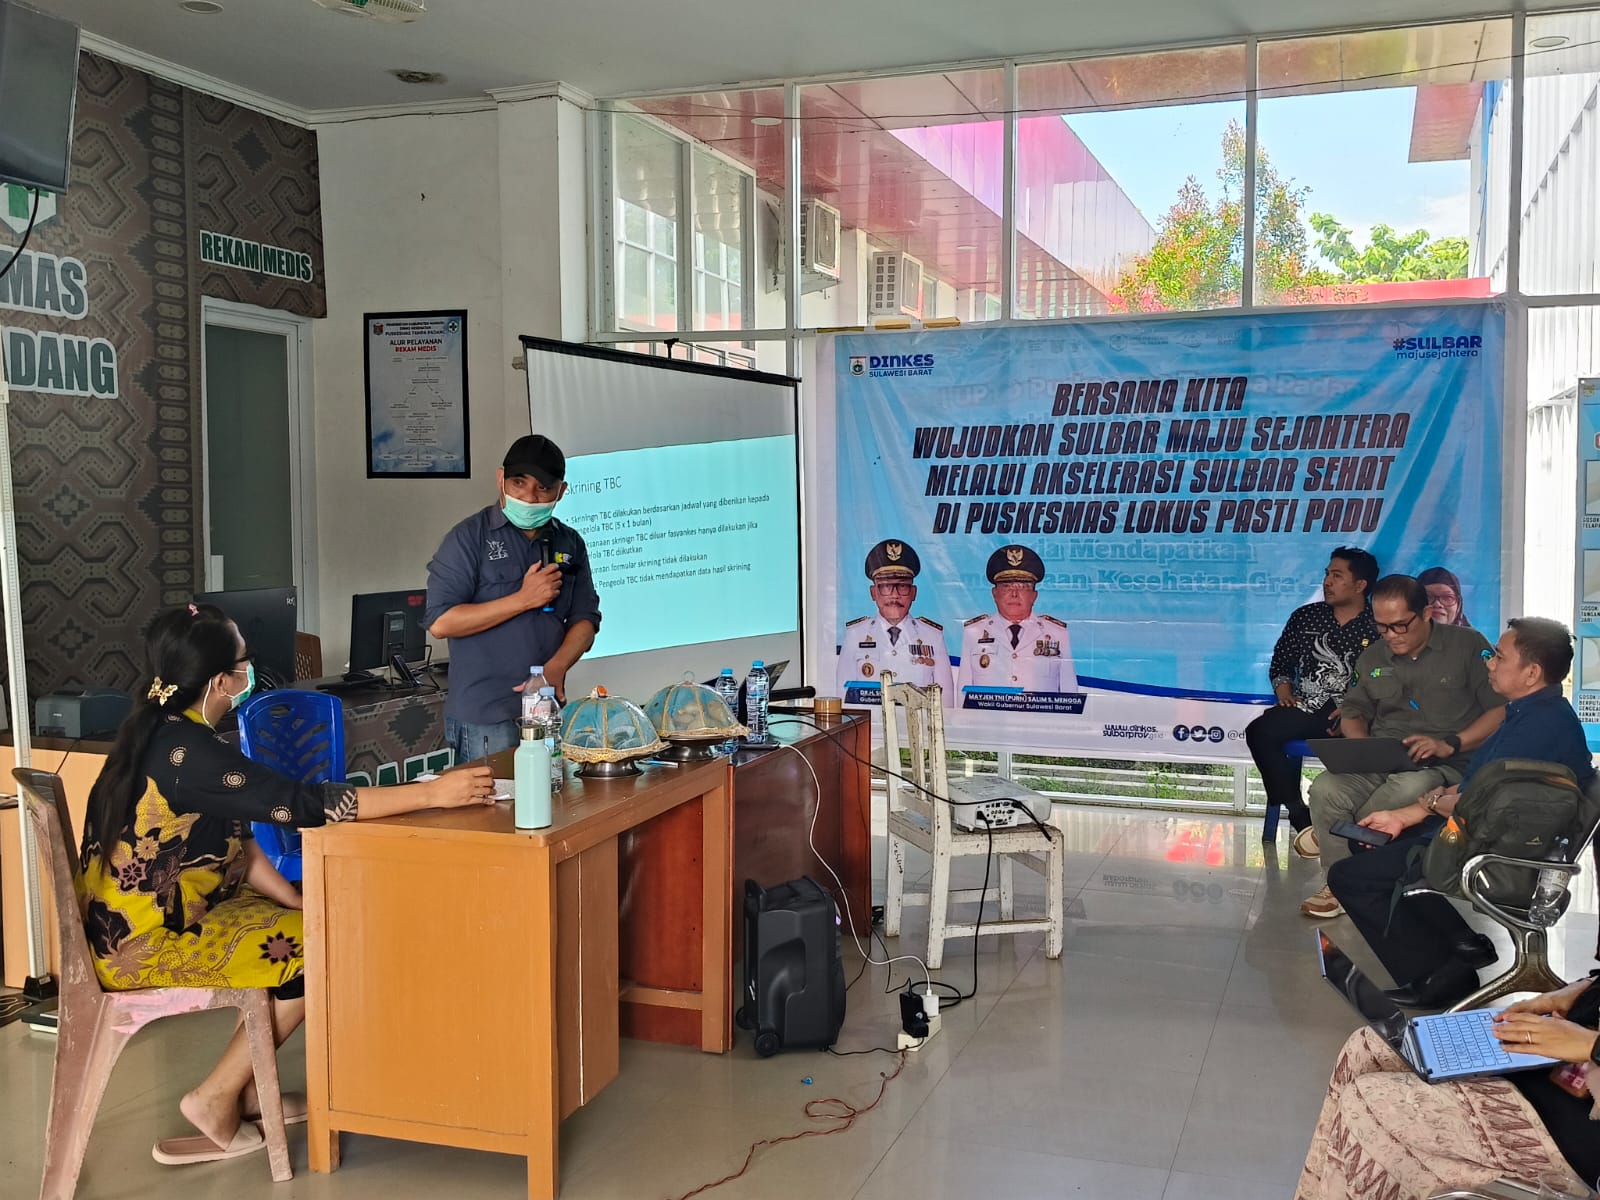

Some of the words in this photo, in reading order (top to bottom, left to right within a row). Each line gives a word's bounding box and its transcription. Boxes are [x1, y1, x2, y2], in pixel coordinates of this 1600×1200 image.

[200, 231, 260, 272] REKAM
[262, 245, 312, 282] MEDIS
[1393, 336, 1482, 351] #SULBAR
[2, 330, 116, 396] DANG
[1397, 349, 1478, 360] majusejahtera
[1052, 378, 1178, 416] BERSAMA
[1182, 376, 1247, 412] KITA
[912, 423, 1054, 459] WUJUDKAN
[1059, 420, 1160, 456] SULBAR
[1165, 418, 1246, 453] MAJU
[1250, 413, 1410, 451] SEJAHTERA
[604, 476, 622, 490] TBC
[925, 463, 1026, 497] MELALUI
[1030, 460, 1185, 495] AKSELERASI
[1189, 457, 1298, 493] SULBAR
[1303, 455, 1396, 491] SEHAT
[600, 511, 613, 520] TBC
[642, 502, 680, 514] berdasarkan
[681, 501, 701, 512] jadwal
[702, 500, 717, 509] yang
[933, 502, 961, 534] DI
[964, 501, 1118, 534] PUSKESMAS
[1124, 500, 1210, 533] LOKUS
[1214, 499, 1300, 533] PASTI
[1302, 498, 1384, 533] PADU
[602, 522, 613, 531] TBC
[636, 533, 648, 541] TBC
[649, 531, 666, 540] diluar
[698, 527, 717, 536] hanya
[718, 522, 746, 532] dilakukan
[747, 521, 758, 531] jika
[603, 549, 614, 557] TBC
[662, 555, 677, 564] tidak
[679, 552, 708, 562] dilakukan
[627, 576, 638, 585] TBC
[639, 573, 654, 582] tidak
[698, 567, 711, 576] data
[712, 564, 726, 573] hasil
[996, 701, 1025, 709] Gubernur
